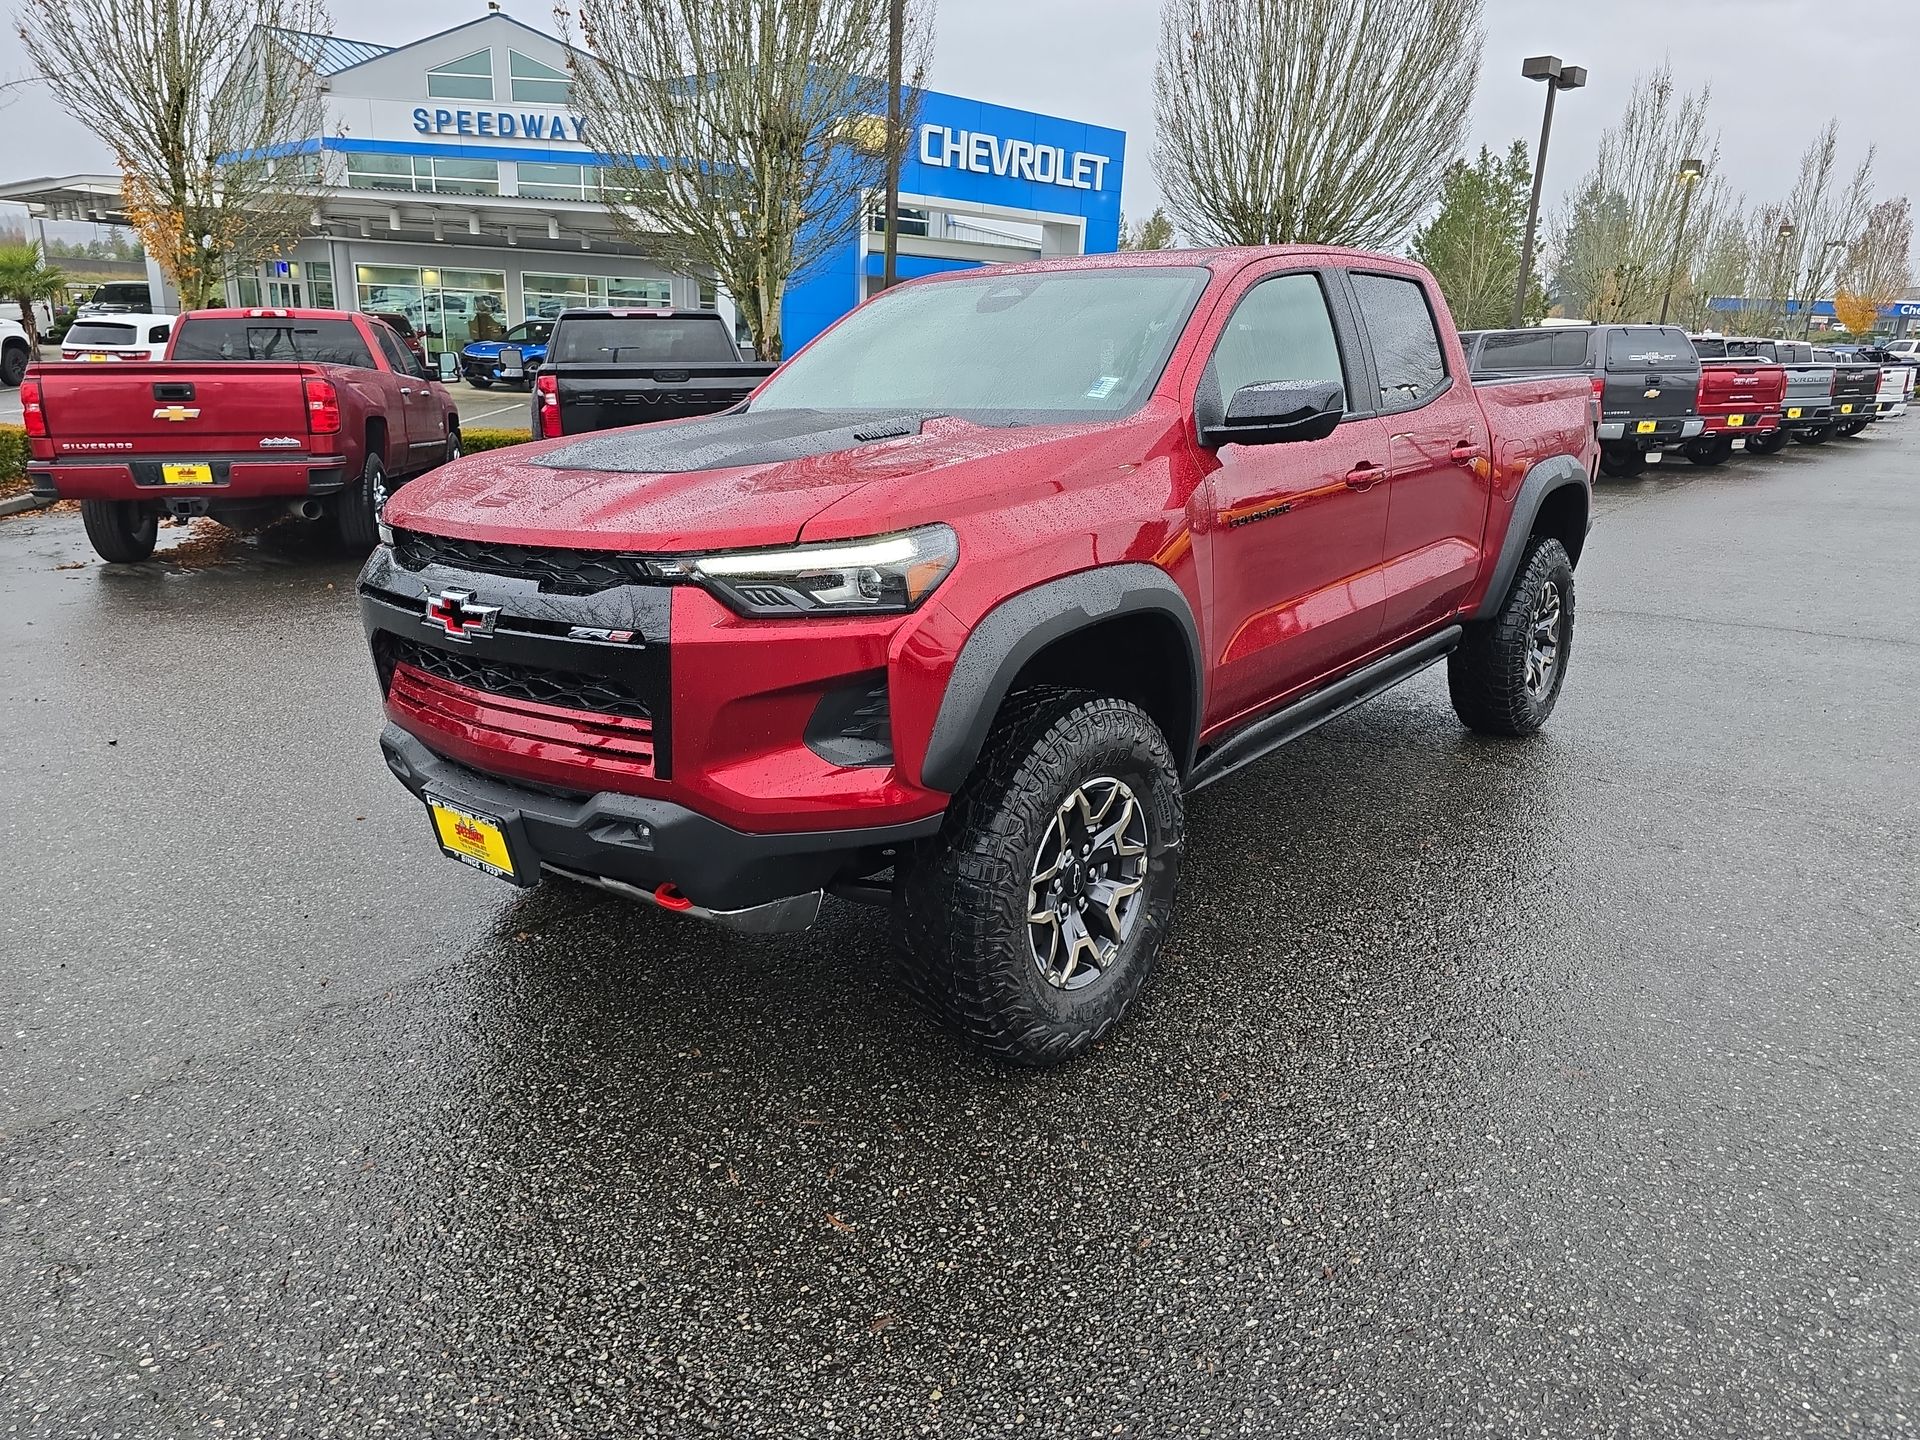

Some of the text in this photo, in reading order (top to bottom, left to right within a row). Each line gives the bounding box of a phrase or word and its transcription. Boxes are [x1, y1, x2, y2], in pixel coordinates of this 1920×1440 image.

[413, 108, 587, 140] SPEEDWAY
[920, 123, 1110, 191] CHEVROLET
[1733, 377, 1759, 386] GMC
[575, 392, 749, 406] CHEVROLE
[62, 442, 133, 450] SILVERADO
[567, 625, 635, 643] ZR2
